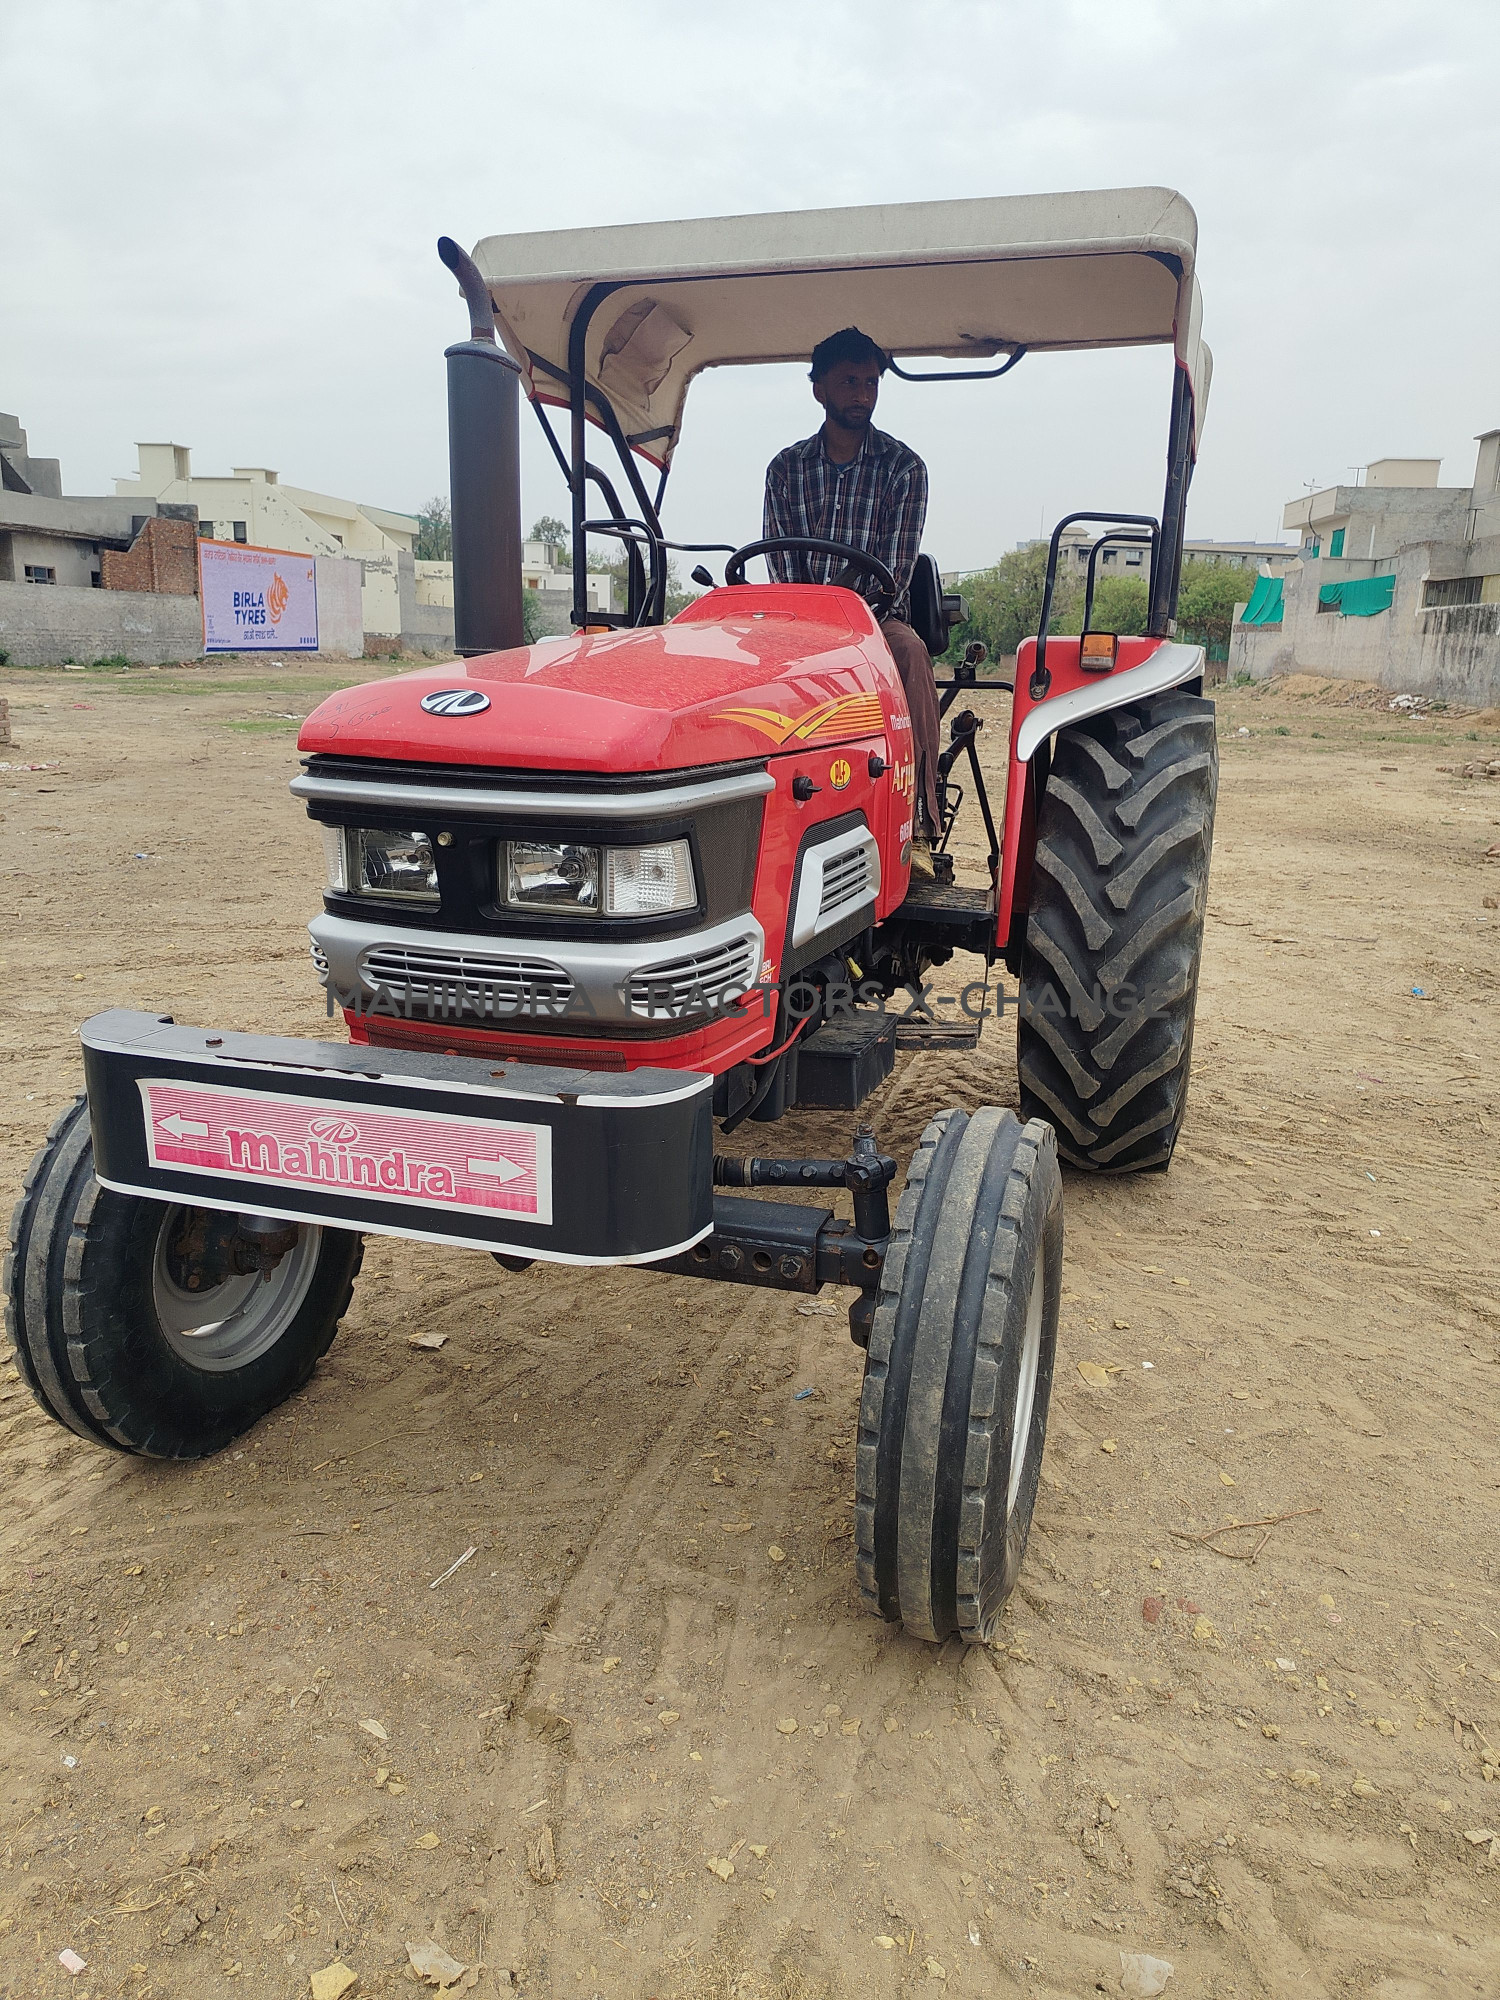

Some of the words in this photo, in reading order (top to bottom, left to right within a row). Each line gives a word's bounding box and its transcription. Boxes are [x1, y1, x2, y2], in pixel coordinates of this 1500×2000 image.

[233, 591, 265, 608] BIRLA
[234, 609, 266, 625] TYRES
[891, 750, 915, 798] Arju
